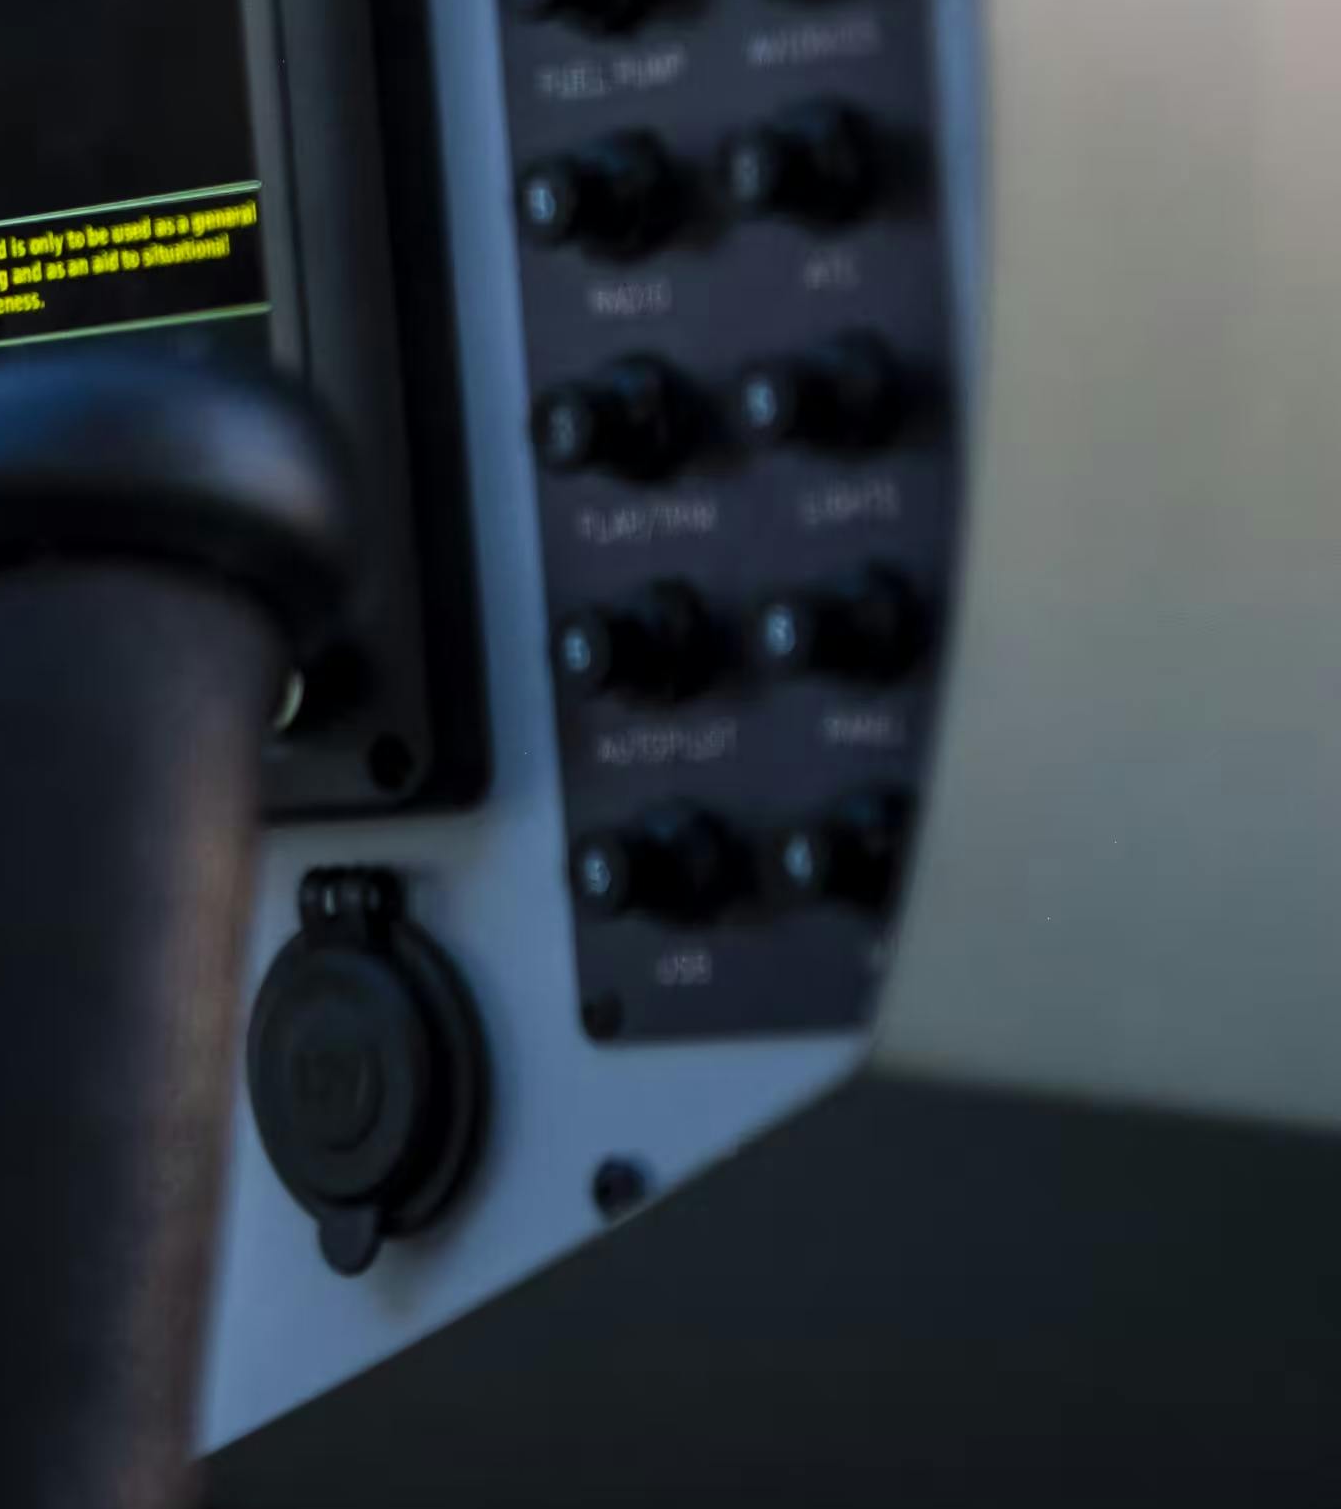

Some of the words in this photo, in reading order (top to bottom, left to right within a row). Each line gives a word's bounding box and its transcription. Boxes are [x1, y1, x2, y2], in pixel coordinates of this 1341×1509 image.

[10, 237, 27, 258] is
[28, 231, 64, 257] only
[66, 229, 85, 249] to
[85, 225, 109, 247] be
[111, 215, 152, 243] used
[153, 218, 176, 239] as
[11, 260, 42, 285] and
[45, 261, 66, 281] as
[67, 257, 89, 278] an
[120, 249, 140, 271] to
